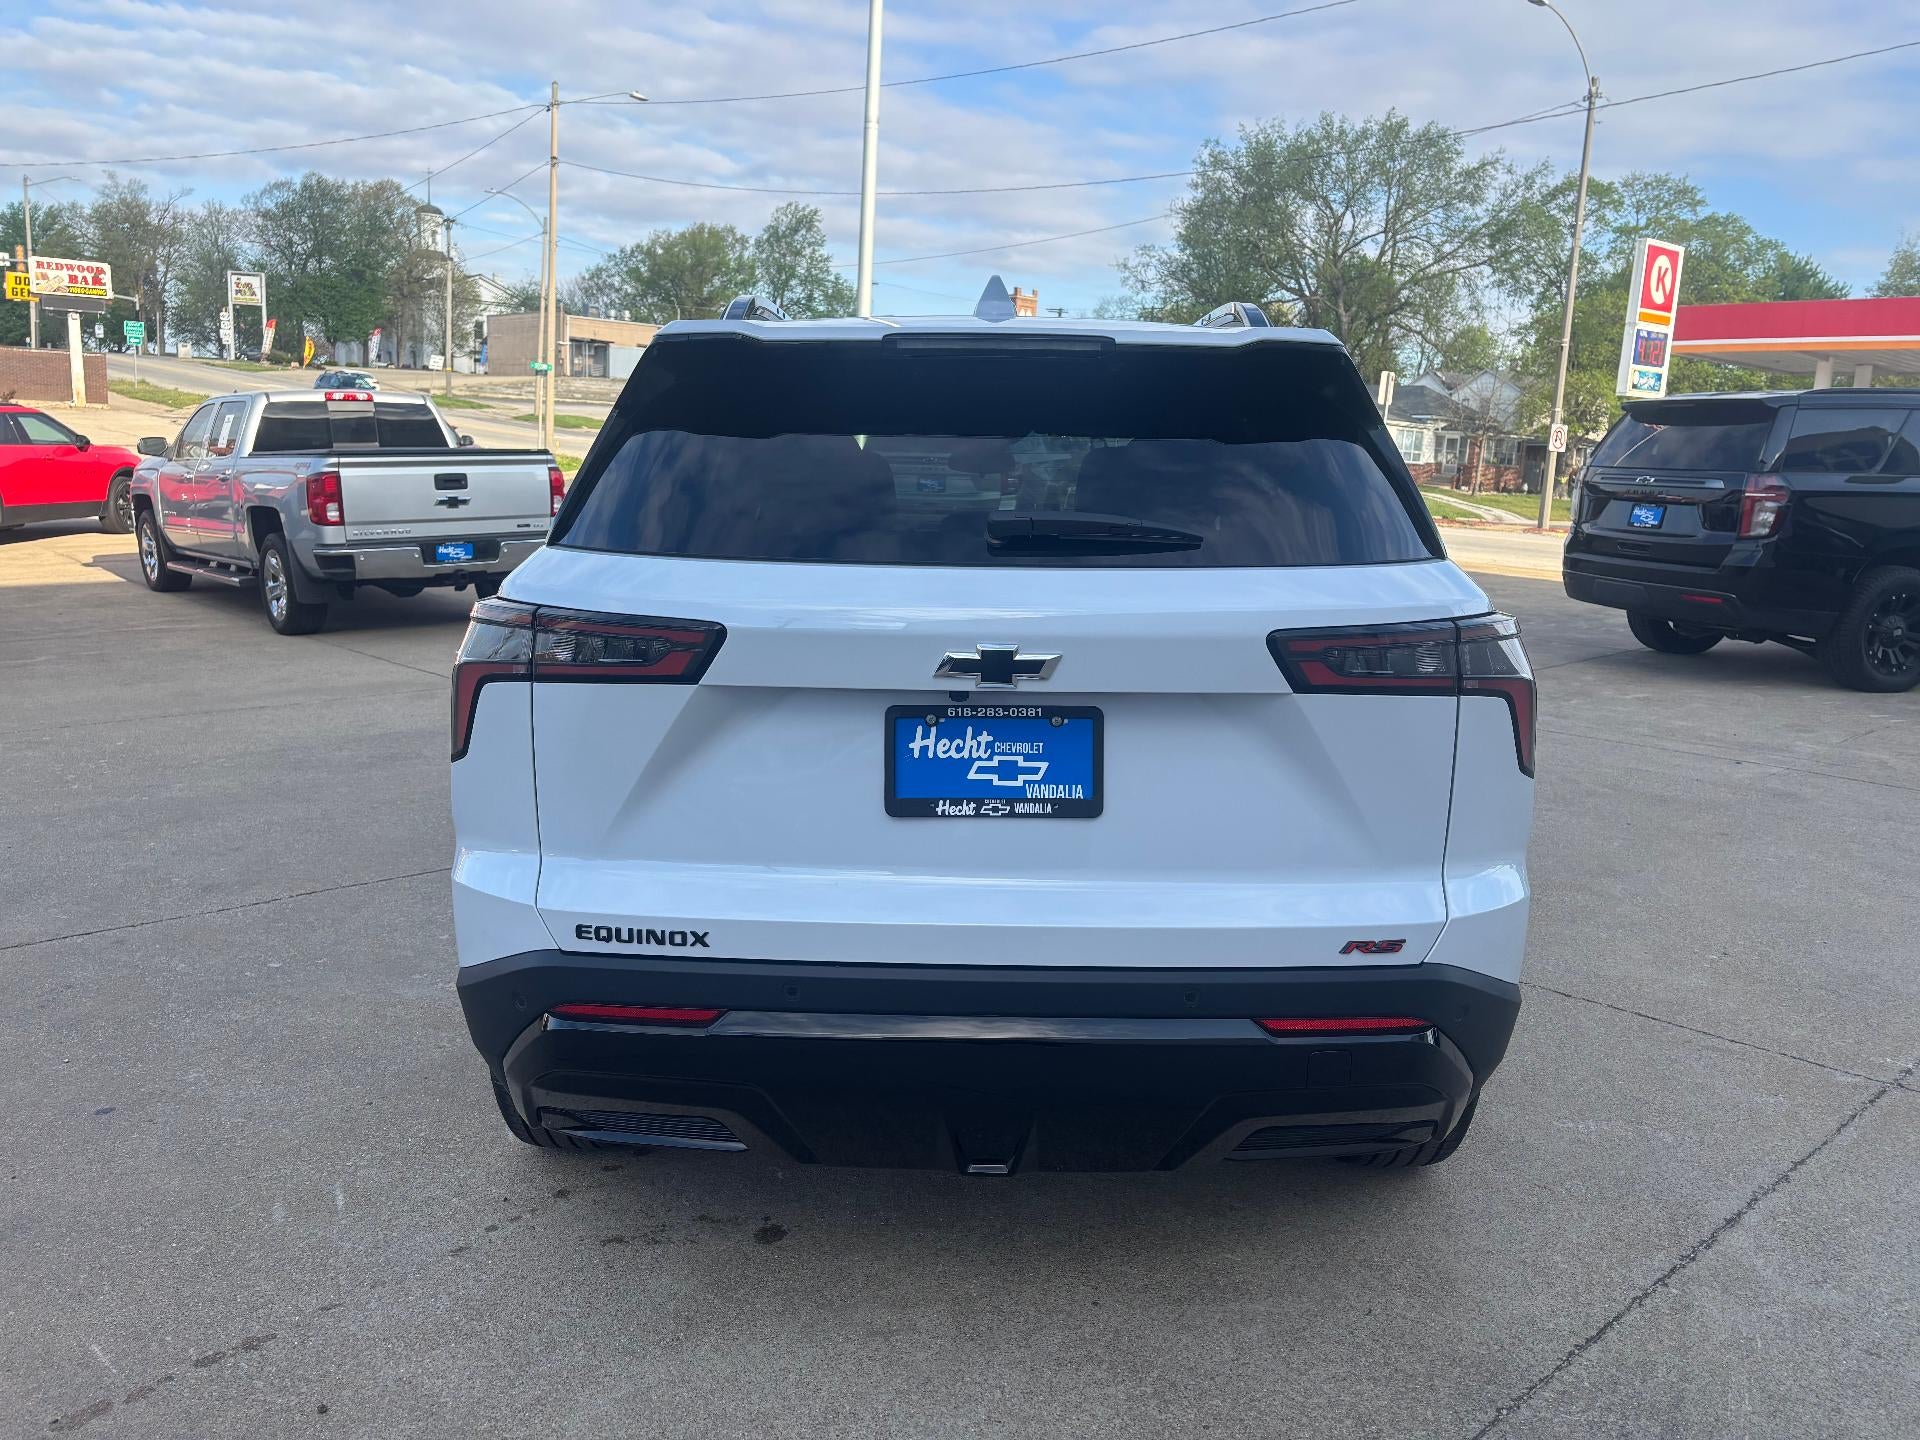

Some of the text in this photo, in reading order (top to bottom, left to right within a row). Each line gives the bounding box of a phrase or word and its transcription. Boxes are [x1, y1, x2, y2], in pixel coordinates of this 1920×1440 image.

[36, 260, 107, 276] REDWOOD
[68, 274, 107, 287] BAR
[1656, 265, 1670, 298] K
[947, 707, 1043, 717] 618-283-0381
[908, 725, 1044, 760] Hecht CHEVROLET
[1025, 783, 1084, 800] VANDALIA
[935, 800, 1053, 816] Hecht VANDALIA
[575, 923, 711, 948] EQUINOX
[1338, 938, 1407, 955] RS
